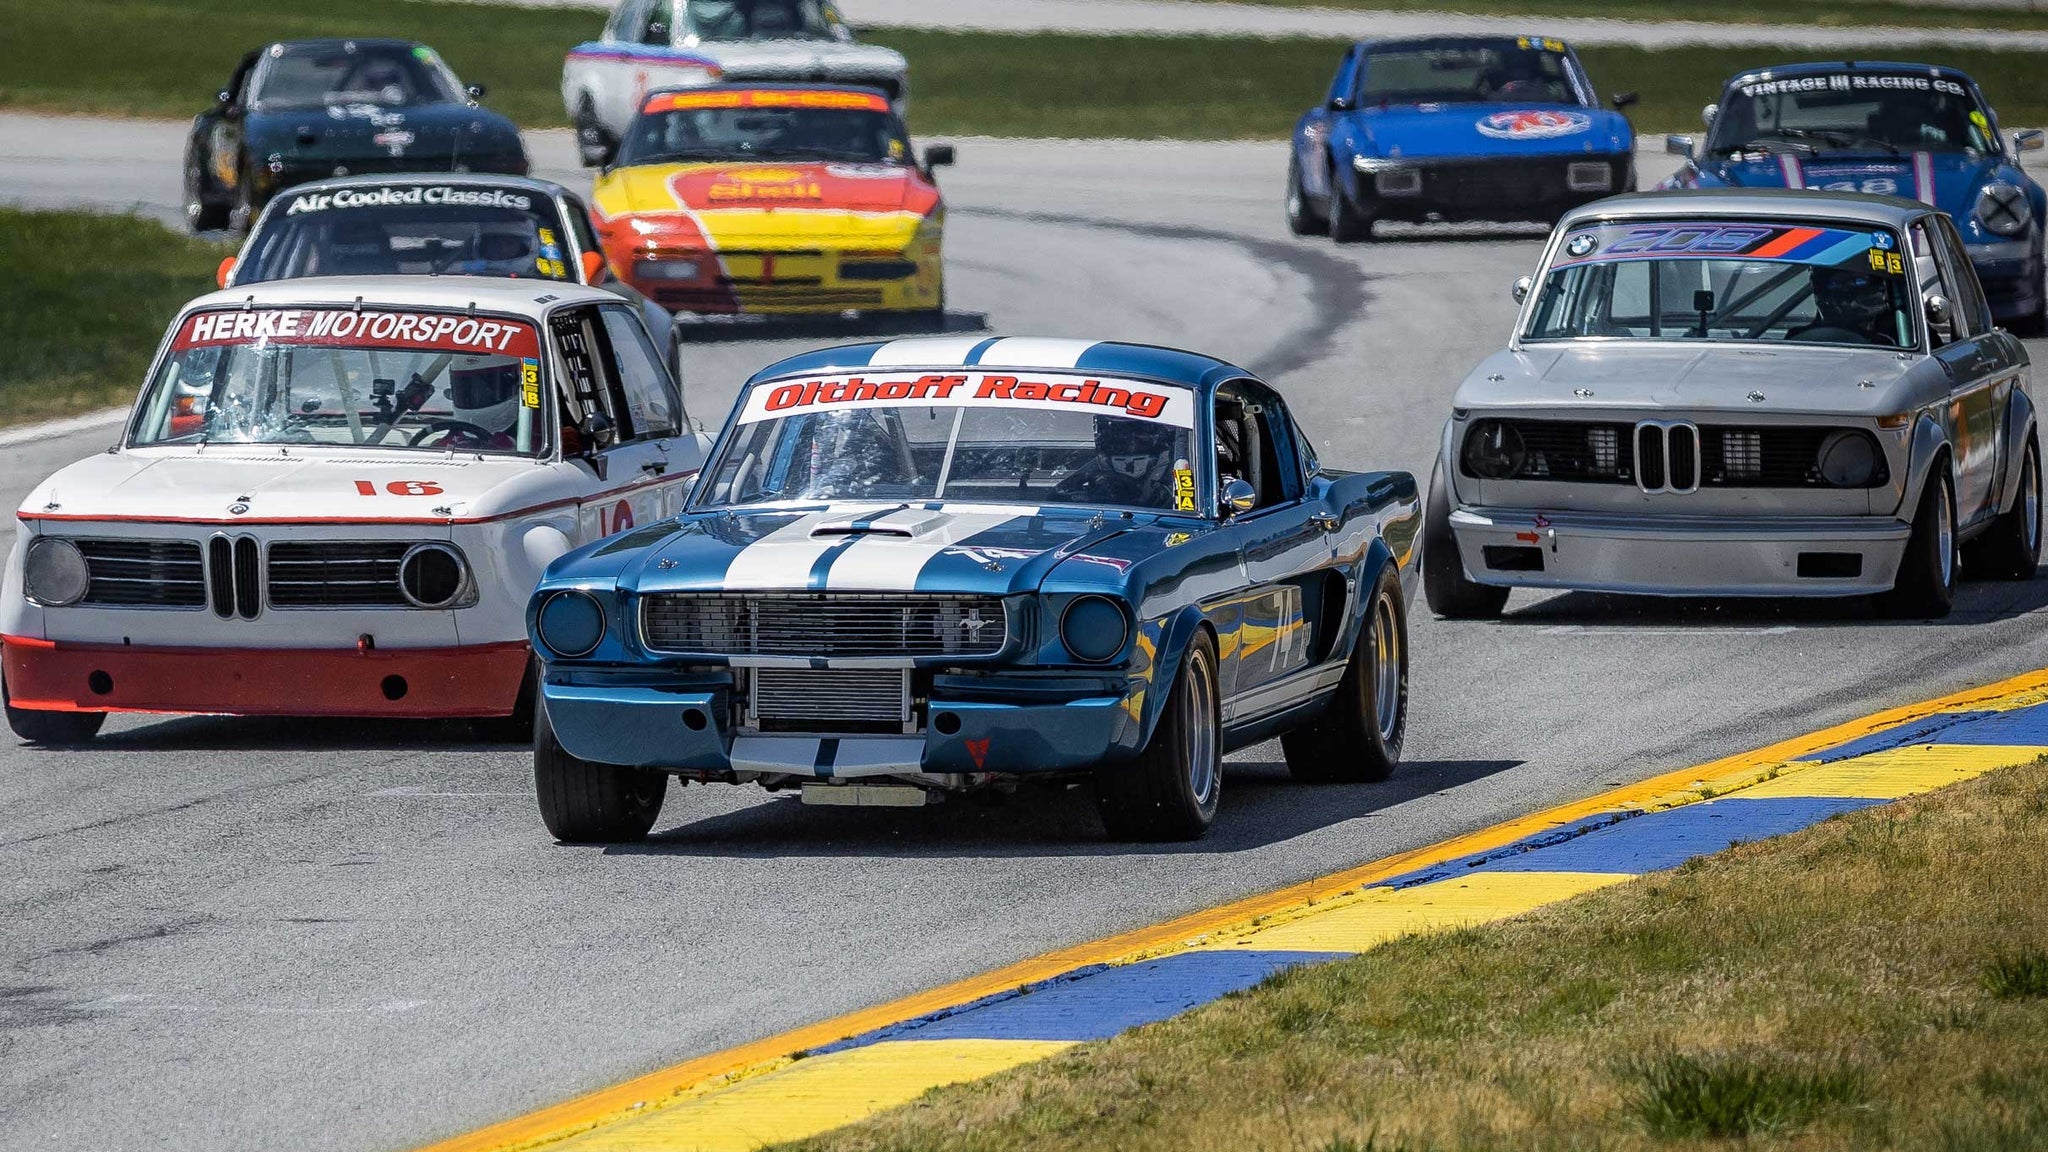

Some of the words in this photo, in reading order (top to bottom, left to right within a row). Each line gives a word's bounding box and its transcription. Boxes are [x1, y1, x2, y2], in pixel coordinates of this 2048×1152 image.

[1742, 78, 1828, 97] VINTAGE
[1852, 76, 1930, 91] RACING
[287, 195, 331, 216] Air
[333, 187, 422, 208] Cooled
[424, 187, 532, 210] Classics
[190, 311, 299, 342] HERKE
[305, 311, 521, 350] MOTORSPORT
[526, 370, 538, 384] 3
[527, 392, 539, 405] B
[765, 375, 967, 412] Olthoff
[976, 376, 1169, 418] Racing
[354, 480, 443, 496] 16
[1180, 476, 1193, 488] 3
[1181, 497, 1194, 508] A
[1269, 589, 1293, 673] 74
